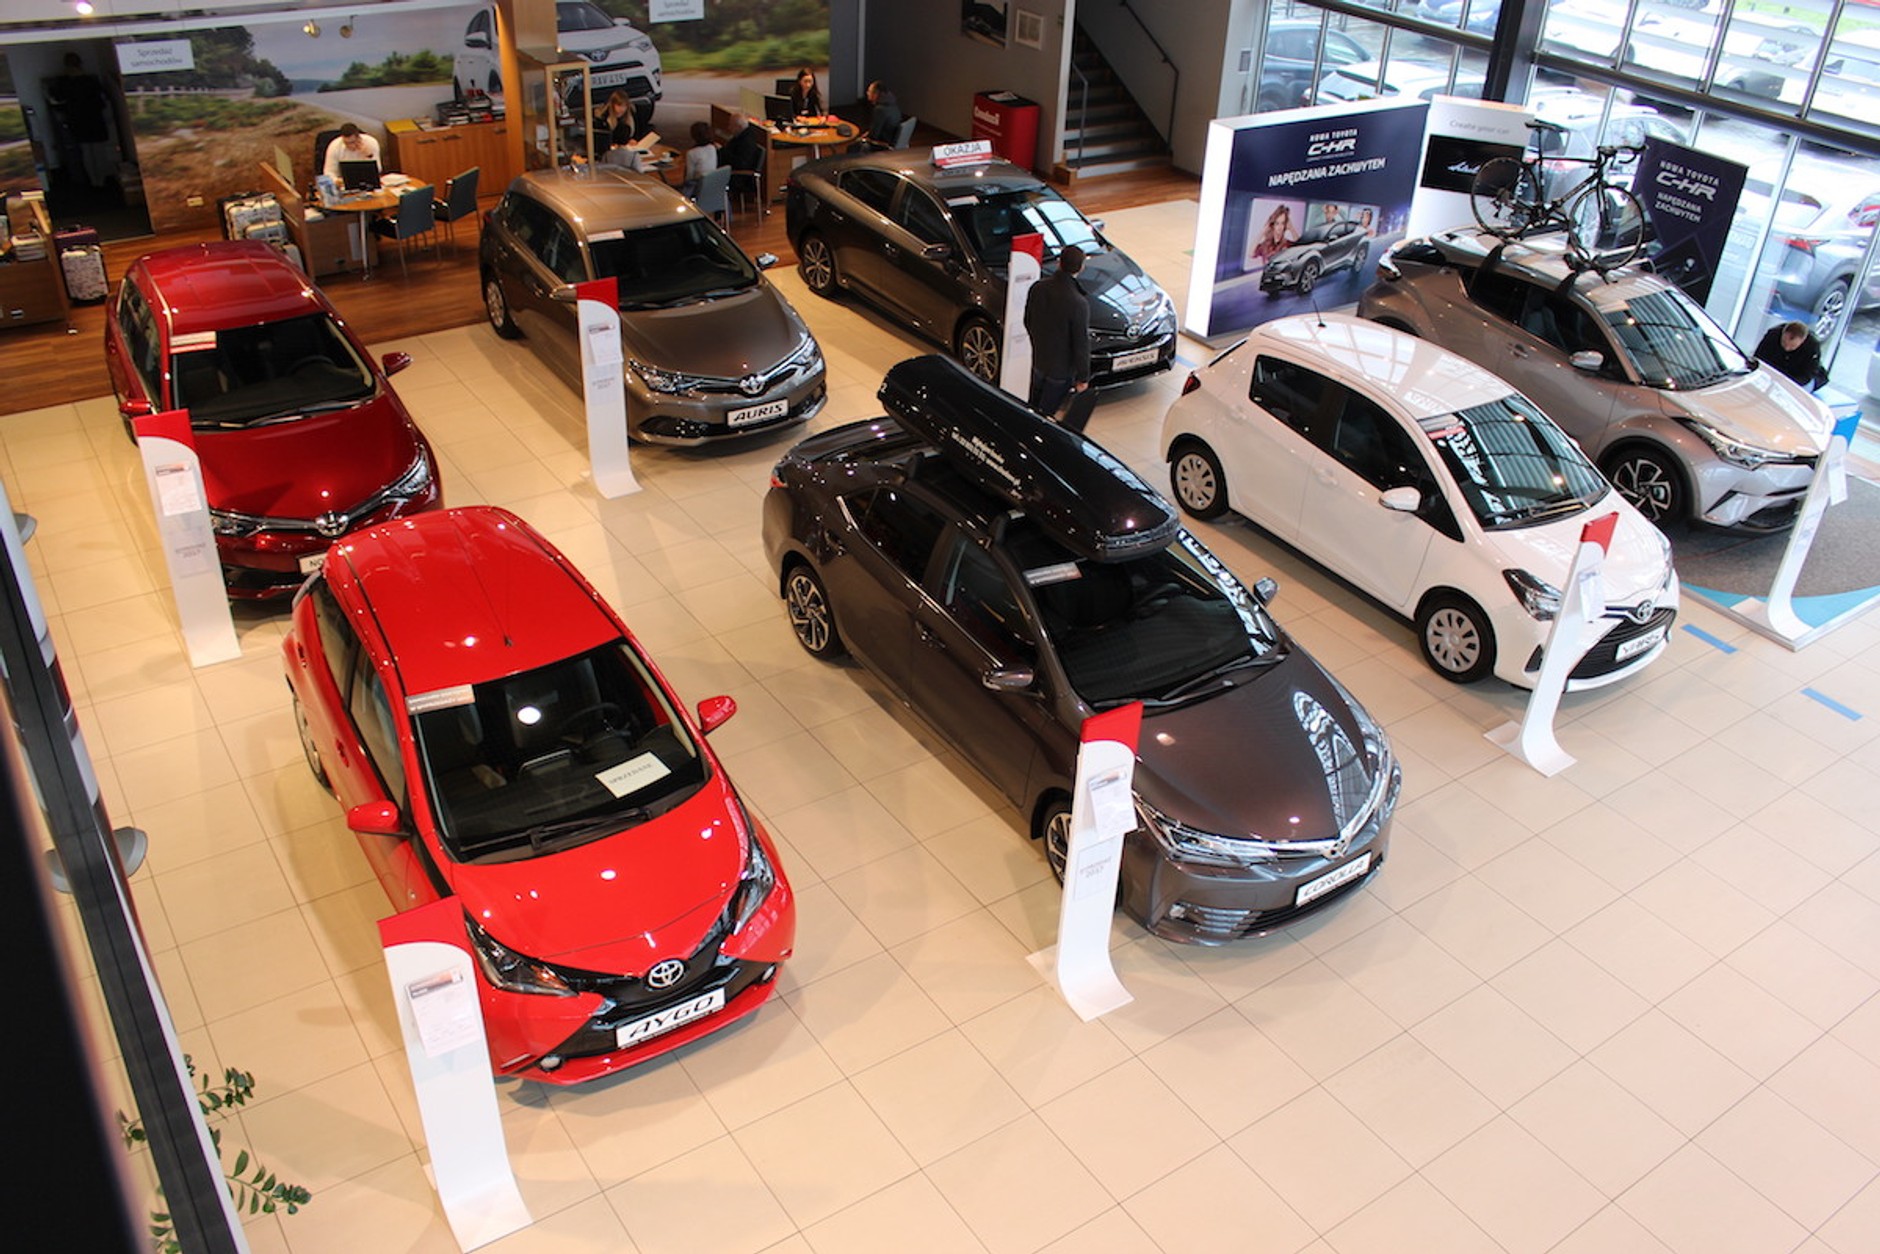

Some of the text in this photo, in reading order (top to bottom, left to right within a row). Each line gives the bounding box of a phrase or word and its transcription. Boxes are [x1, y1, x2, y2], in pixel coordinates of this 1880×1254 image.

[1307, 138, 1357, 156] C-HR
[1309, 128, 1358, 143] NOWA TOYOTA
[943, 143, 982, 157] OKAZJA
[1268, 157, 1387, 188] NAPĘDZANA ZACHWYTEM
[1659, 161, 1720, 187] NOWA TOYOTA
[1655, 171, 1717, 202] C-HR
[733, 402, 784, 422] AURIS
[1303, 860, 1365, 897] COROLLA
[629, 996, 714, 1038] AYGO
